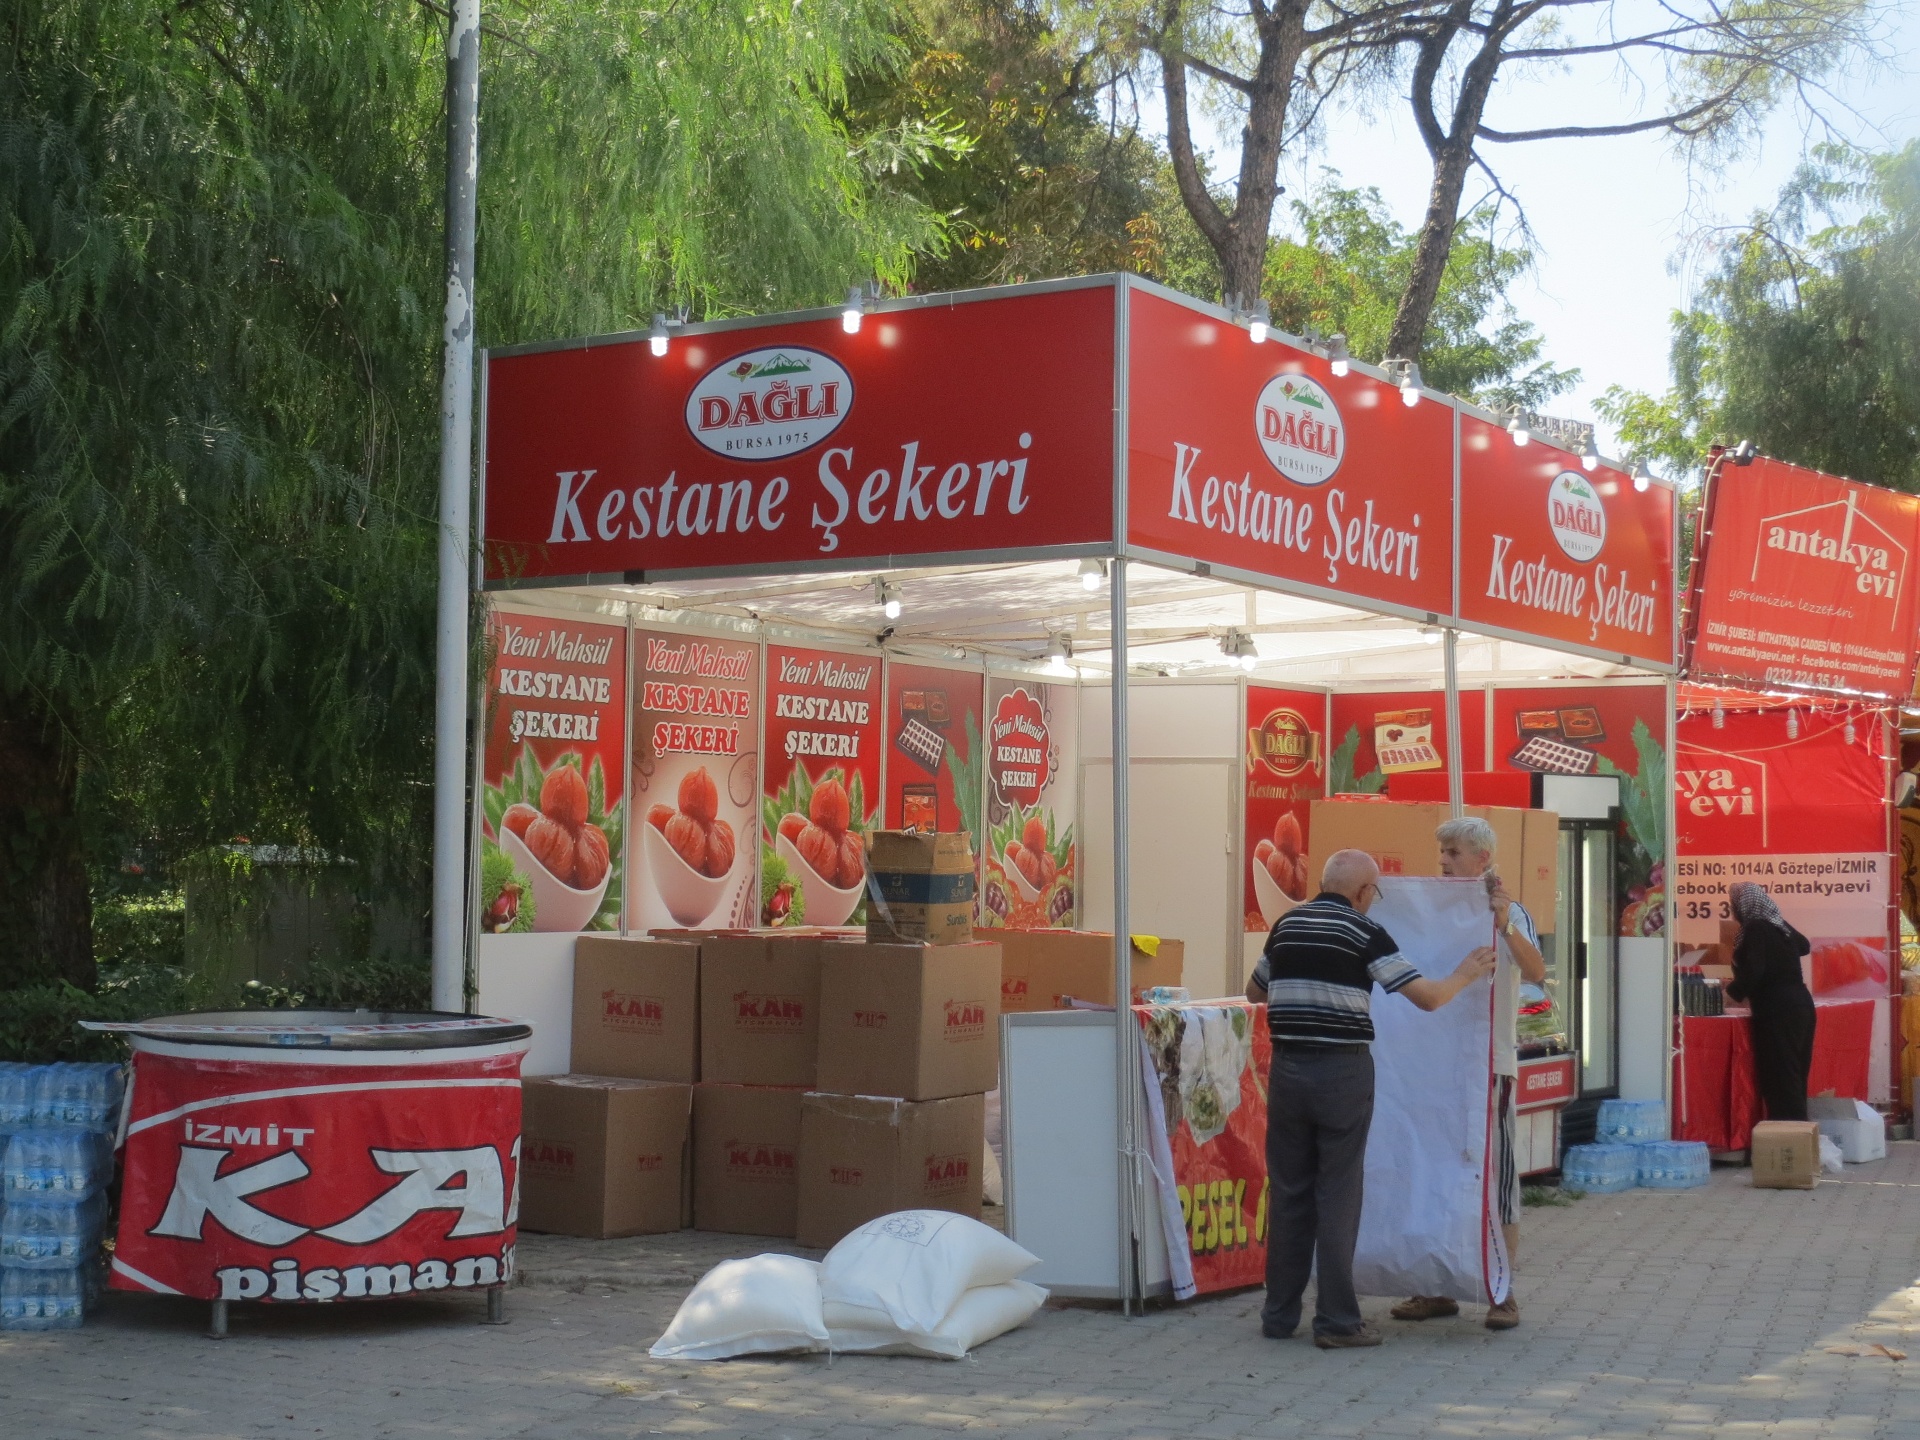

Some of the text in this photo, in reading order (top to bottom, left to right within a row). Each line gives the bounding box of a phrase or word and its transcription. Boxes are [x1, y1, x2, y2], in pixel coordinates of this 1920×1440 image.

[698, 380, 840, 432] DAĞLI
[725, 432, 810, 451] BURSA 1975
[1262, 405, 1338, 460] DAĞLI
[1277, 455, 1323, 478] BURSA 1975
[546, 432, 1033, 552] Kestane Şekeri
[1168, 441, 1419, 584] Kestane Şekeri
[1552, 498, 1602, 540] DAĞLI
[1767, 490, 1889, 573] antakya
[1486, 534, 1656, 641] Kestane Şekeri
[1728, 588, 1795, 608] yöremizin
[1856, 570, 1897, 599] evi
[502, 624, 613, 665] Yeni Mahsül
[645, 637, 753, 681] Yeni Mahsül
[1707, 642, 1795, 663] www.antakyaevi.net
[499, 668, 611, 704] KESTANE
[779, 655, 872, 692] Yeni Mahsül
[1765, 666, 1792, 682] 0232
[642, 682, 750, 719] KESTANE
[775, 694, 870, 726] KESTANE
[509, 710, 600, 744] ŞEKERİ
[652, 721, 740, 759] ŞEKERİ
[994, 714, 1046, 742] Yeni Mahsül
[783, 729, 860, 761] ŞEKERİ
[996, 745, 1042, 765] KESTANE
[1265, 730, 1306, 757] DAĞLI
[1001, 769, 1037, 790] ŞEKERİ
[1248, 780, 1288, 799] Kestane
[1689, 786, 1756, 817] evi
[1674, 857, 1877, 878] ESİ NO: 1014/A Göztepe/İZMİR
[1686, 901, 1711, 919] 35
[1718, 901, 1731, 919] 3
[185, 1118, 315, 1146] İZMİT
[146, 1134, 522, 1248] KA
